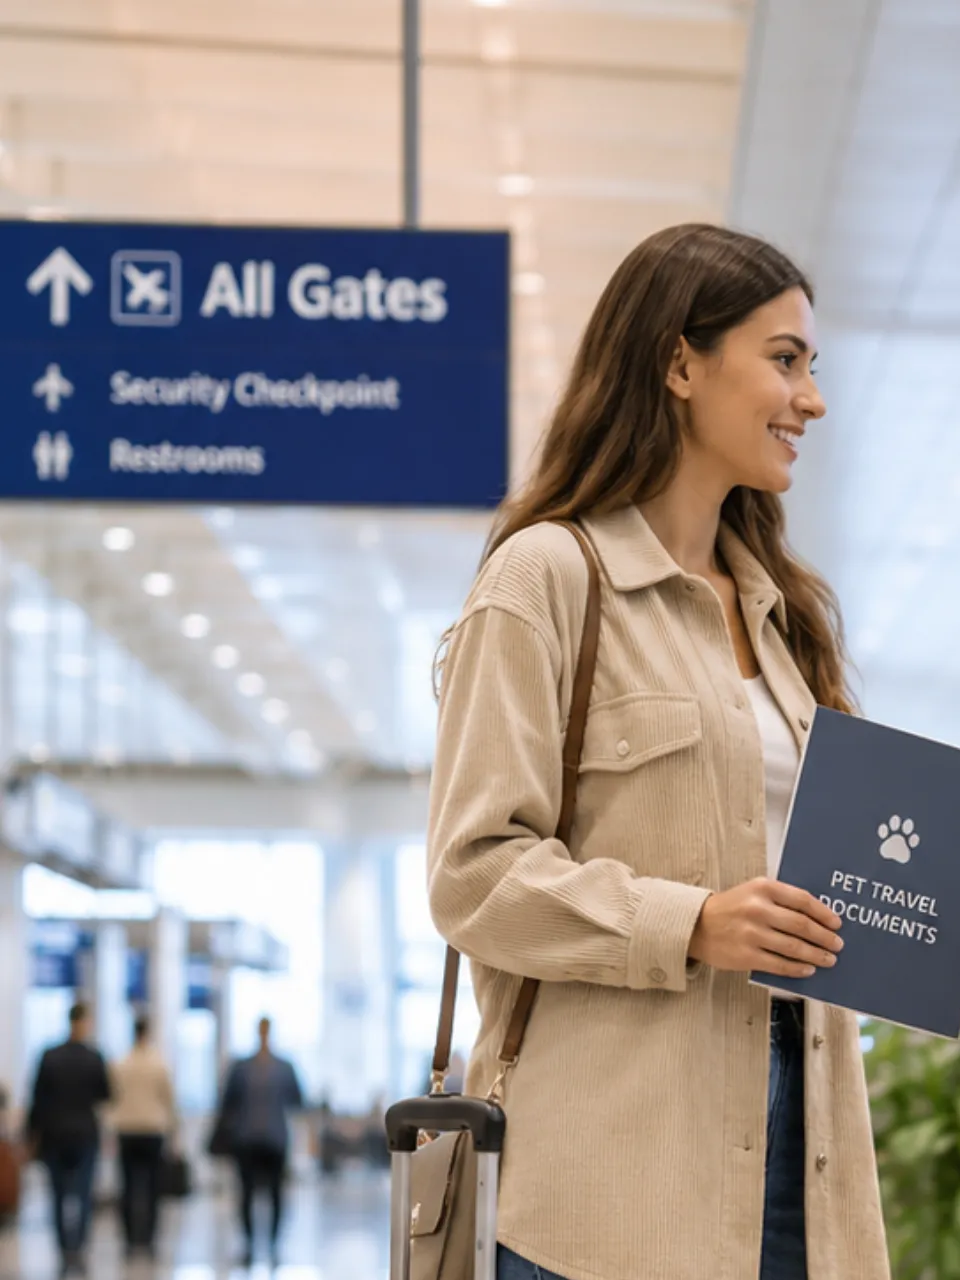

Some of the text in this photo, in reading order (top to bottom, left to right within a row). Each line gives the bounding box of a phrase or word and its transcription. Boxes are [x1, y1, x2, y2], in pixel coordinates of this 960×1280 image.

[200, 260, 447, 322] All Gates
[110, 371, 400, 415] Security Checkpoint
[109, 438, 265, 475] Restrooms
[830, 870, 938, 917] PET TRAVEL
